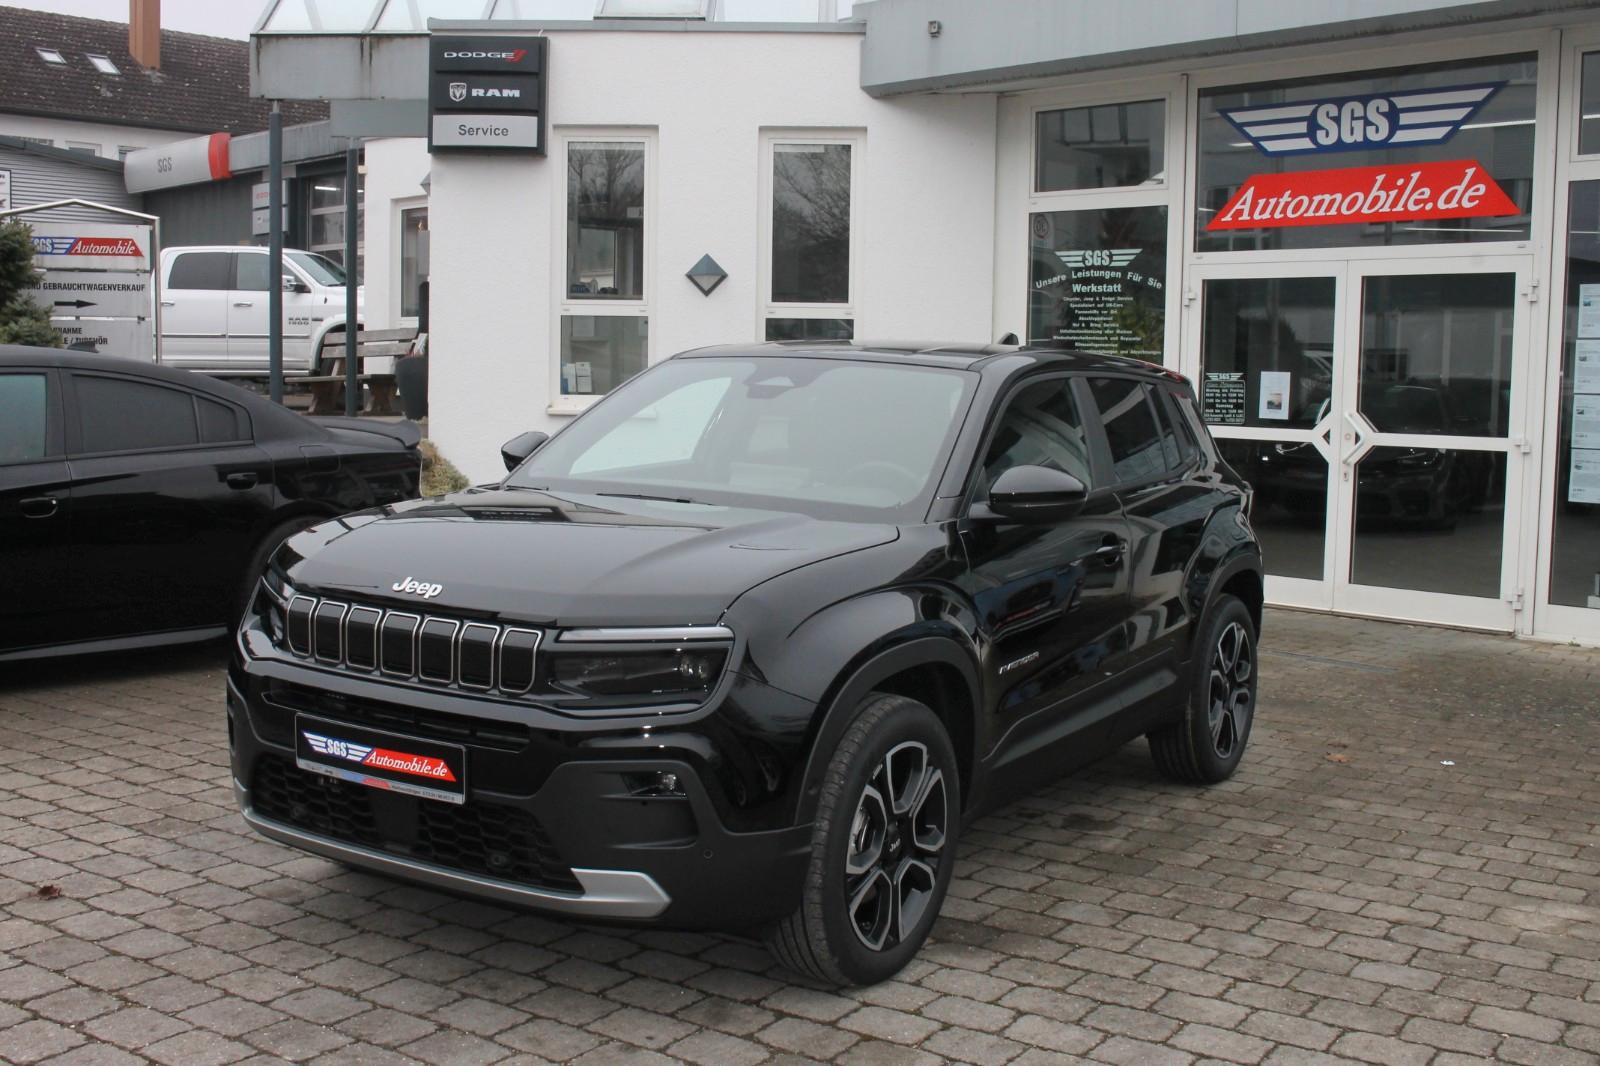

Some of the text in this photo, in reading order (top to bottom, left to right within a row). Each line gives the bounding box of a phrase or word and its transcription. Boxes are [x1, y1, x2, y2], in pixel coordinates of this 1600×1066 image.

[471, 88, 520, 97] RAM
[1316, 98, 1390, 146] SGS
[458, 124, 509, 137] Service
[157, 156, 172, 173] SGS
[1221, 167, 1487, 222] Automobile.de
[34, 238, 135, 254] SGS Automobile
[1084, 250, 1110, 266] SGS
[43, 283, 145, 292] GEBRAUCHTWAGENVERKAUF
[1035, 269, 1163, 290] Unsere Leistungen Für Sie
[1072, 284, 1122, 293] Werkstatt
[392, 576, 443, 599] Jeep
[327, 739, 448, 777] SGS Automobile.de
